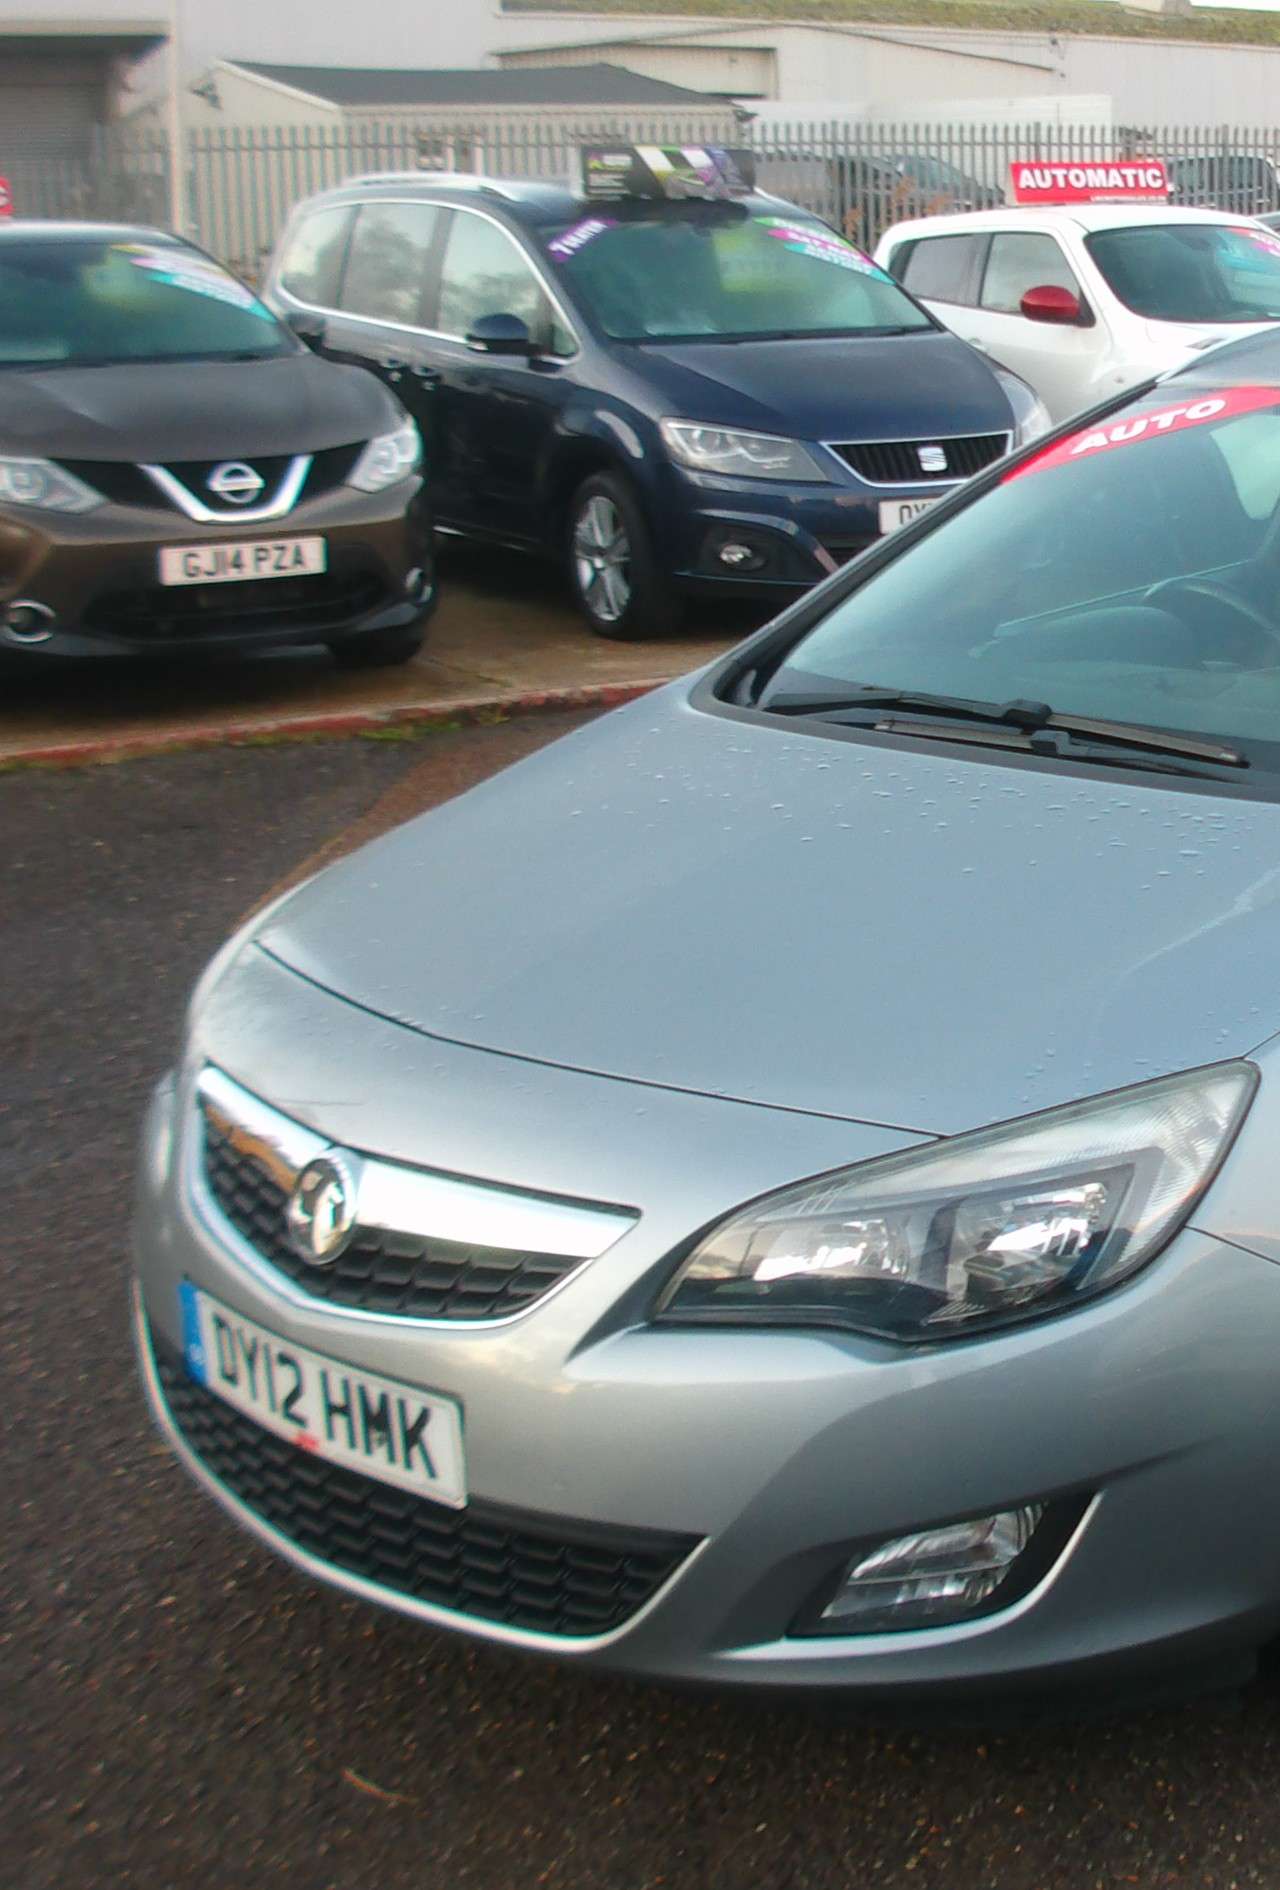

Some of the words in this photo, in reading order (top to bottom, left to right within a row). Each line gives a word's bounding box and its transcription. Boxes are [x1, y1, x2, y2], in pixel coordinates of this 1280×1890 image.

[1018, 168, 1164, 189] AUTOMATIC
[1071, 399, 1227, 455] AUTO
[182, 549, 244, 578] GJ14
[254, 545, 306, 572] PZA
[212, 1311, 308, 1429] DY12
[320, 1367, 437, 1479] HMK
